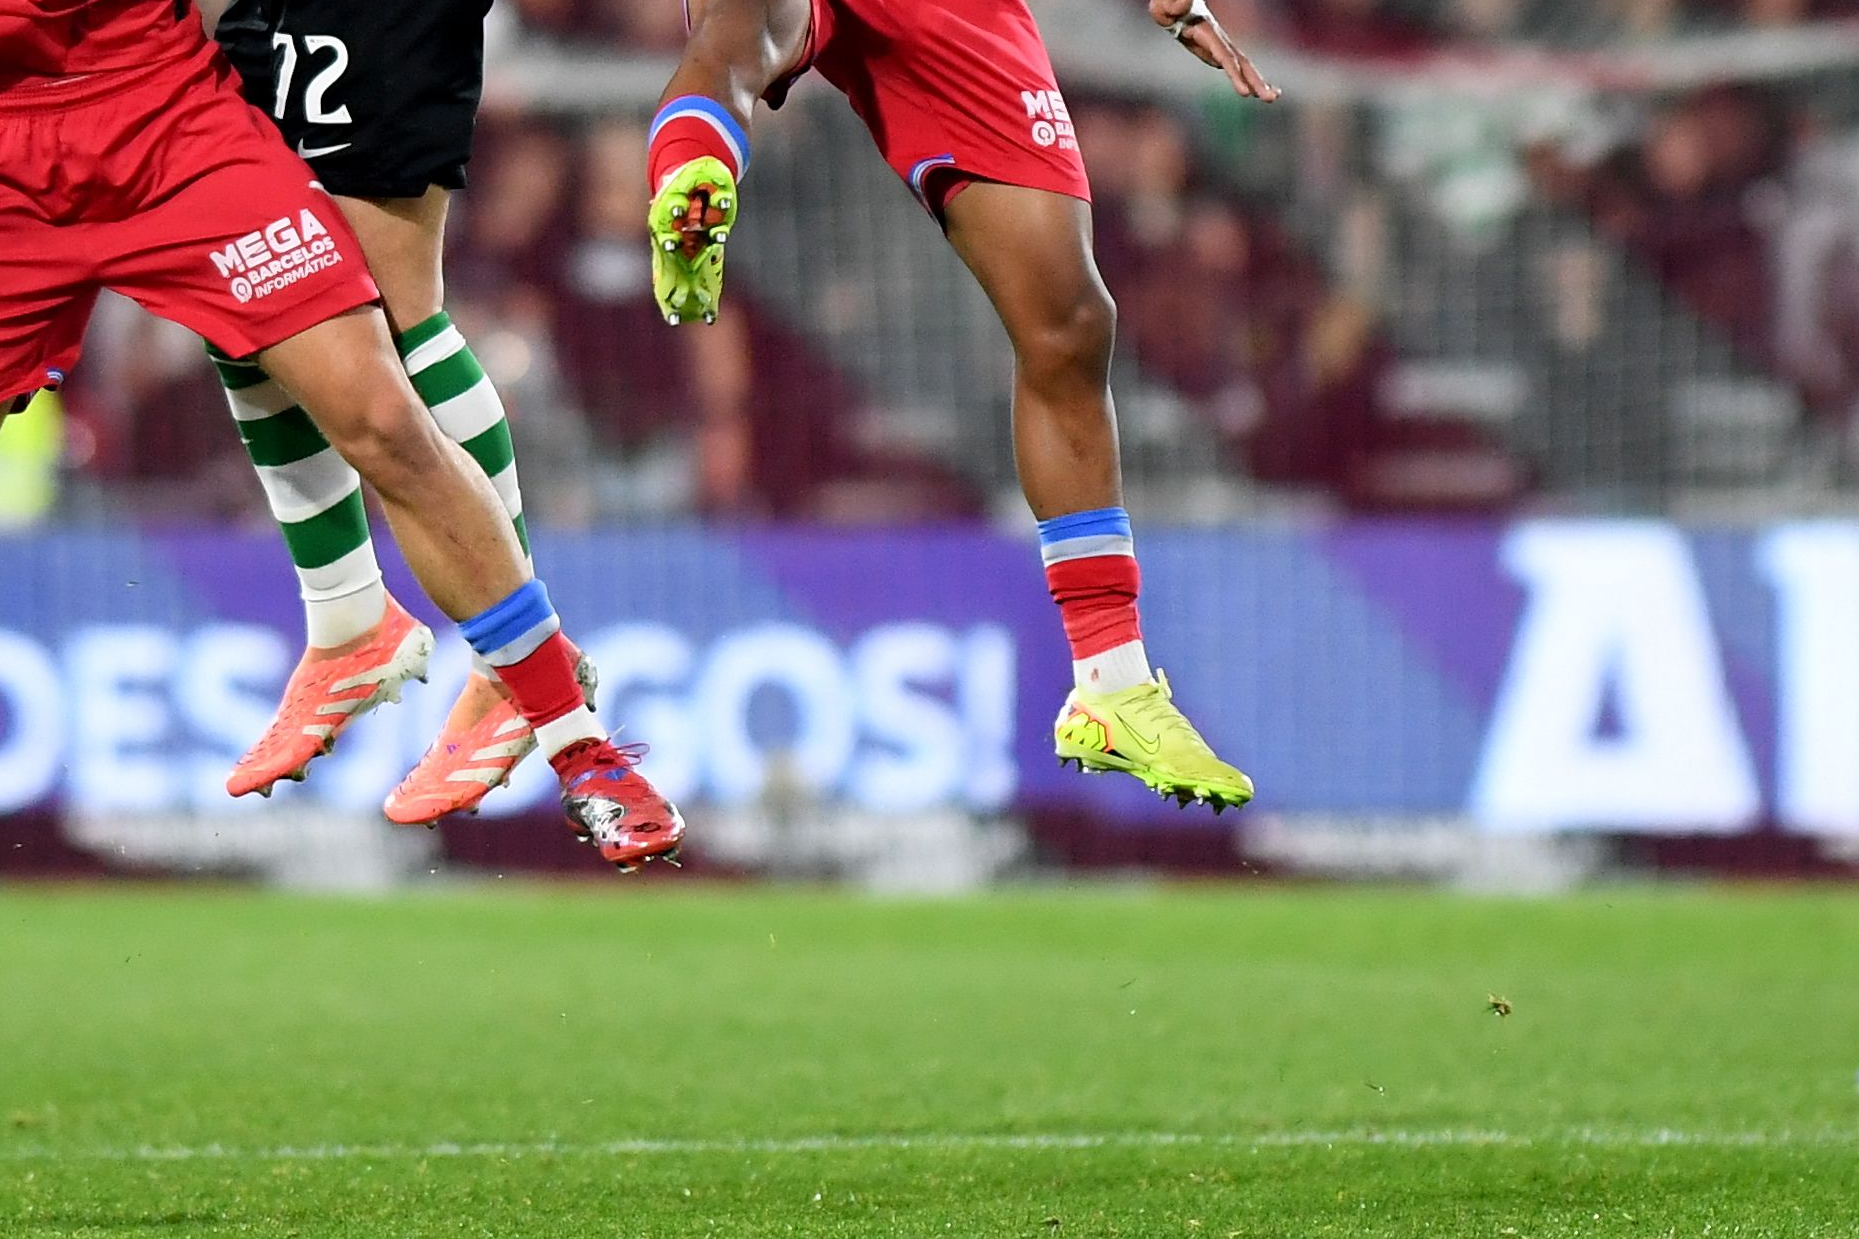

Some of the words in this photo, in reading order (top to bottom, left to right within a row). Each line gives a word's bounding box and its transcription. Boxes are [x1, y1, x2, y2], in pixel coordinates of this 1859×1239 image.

[272, 31, 353, 124] 72
[209, 207, 328, 279] MEGA
[247, 236, 336, 286] BARCELOS
[254, 249, 344, 300] INFORMÁTICA
